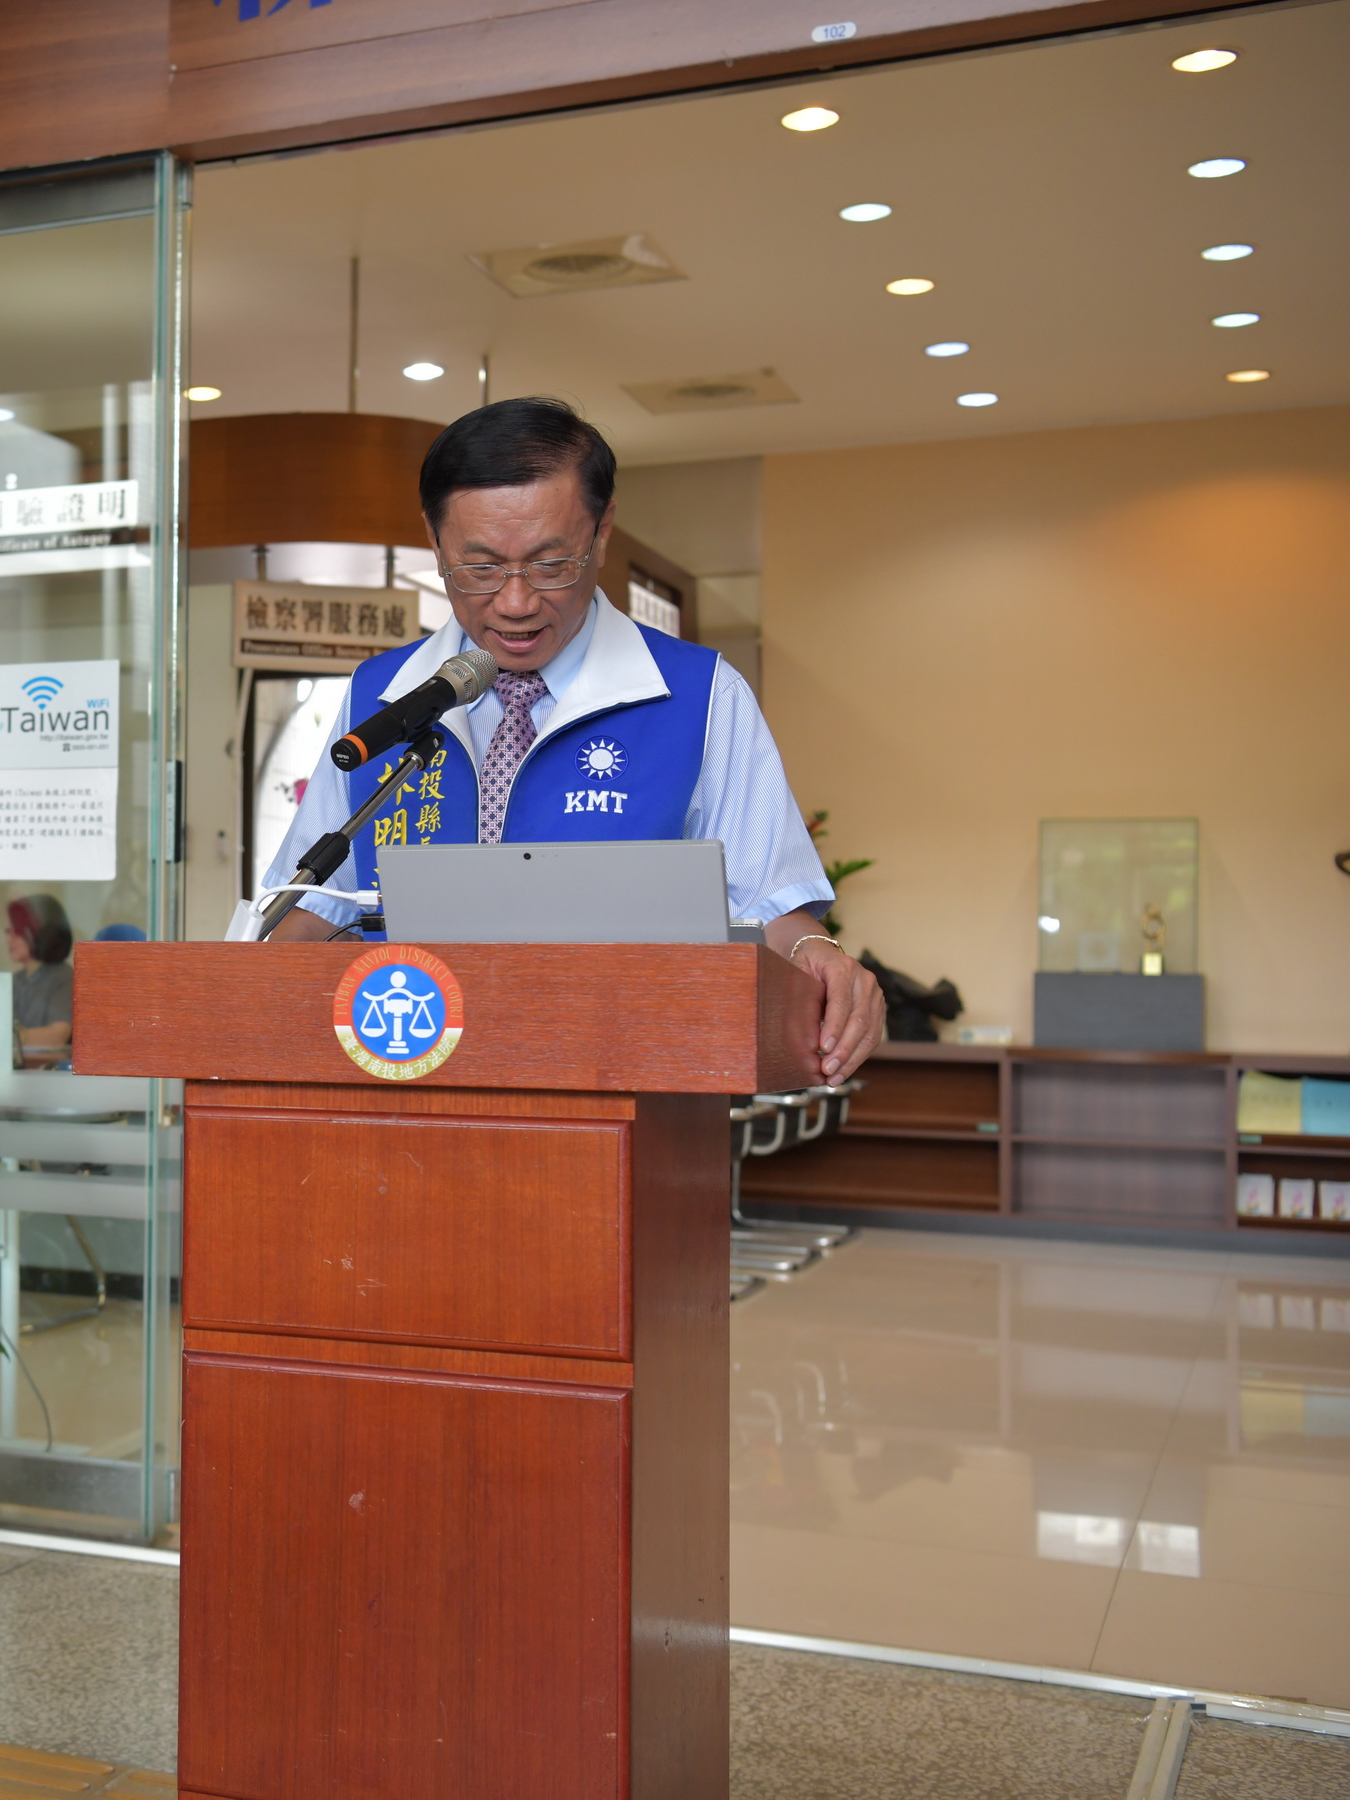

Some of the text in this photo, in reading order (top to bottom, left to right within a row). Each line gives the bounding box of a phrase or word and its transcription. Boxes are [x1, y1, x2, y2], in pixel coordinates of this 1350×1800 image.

[824, 25, 846, 39] 102
[246, 596, 406, 638] 檢察署服務處
[87, 699, 110, 708] WiFi
[564, 789, 628, 813] KMT
[335, 946, 463, 1019] TAIWAN NANTOU DISTRICT COURT
[344, 1036, 456, 1079] 臺灣南投地方法院
